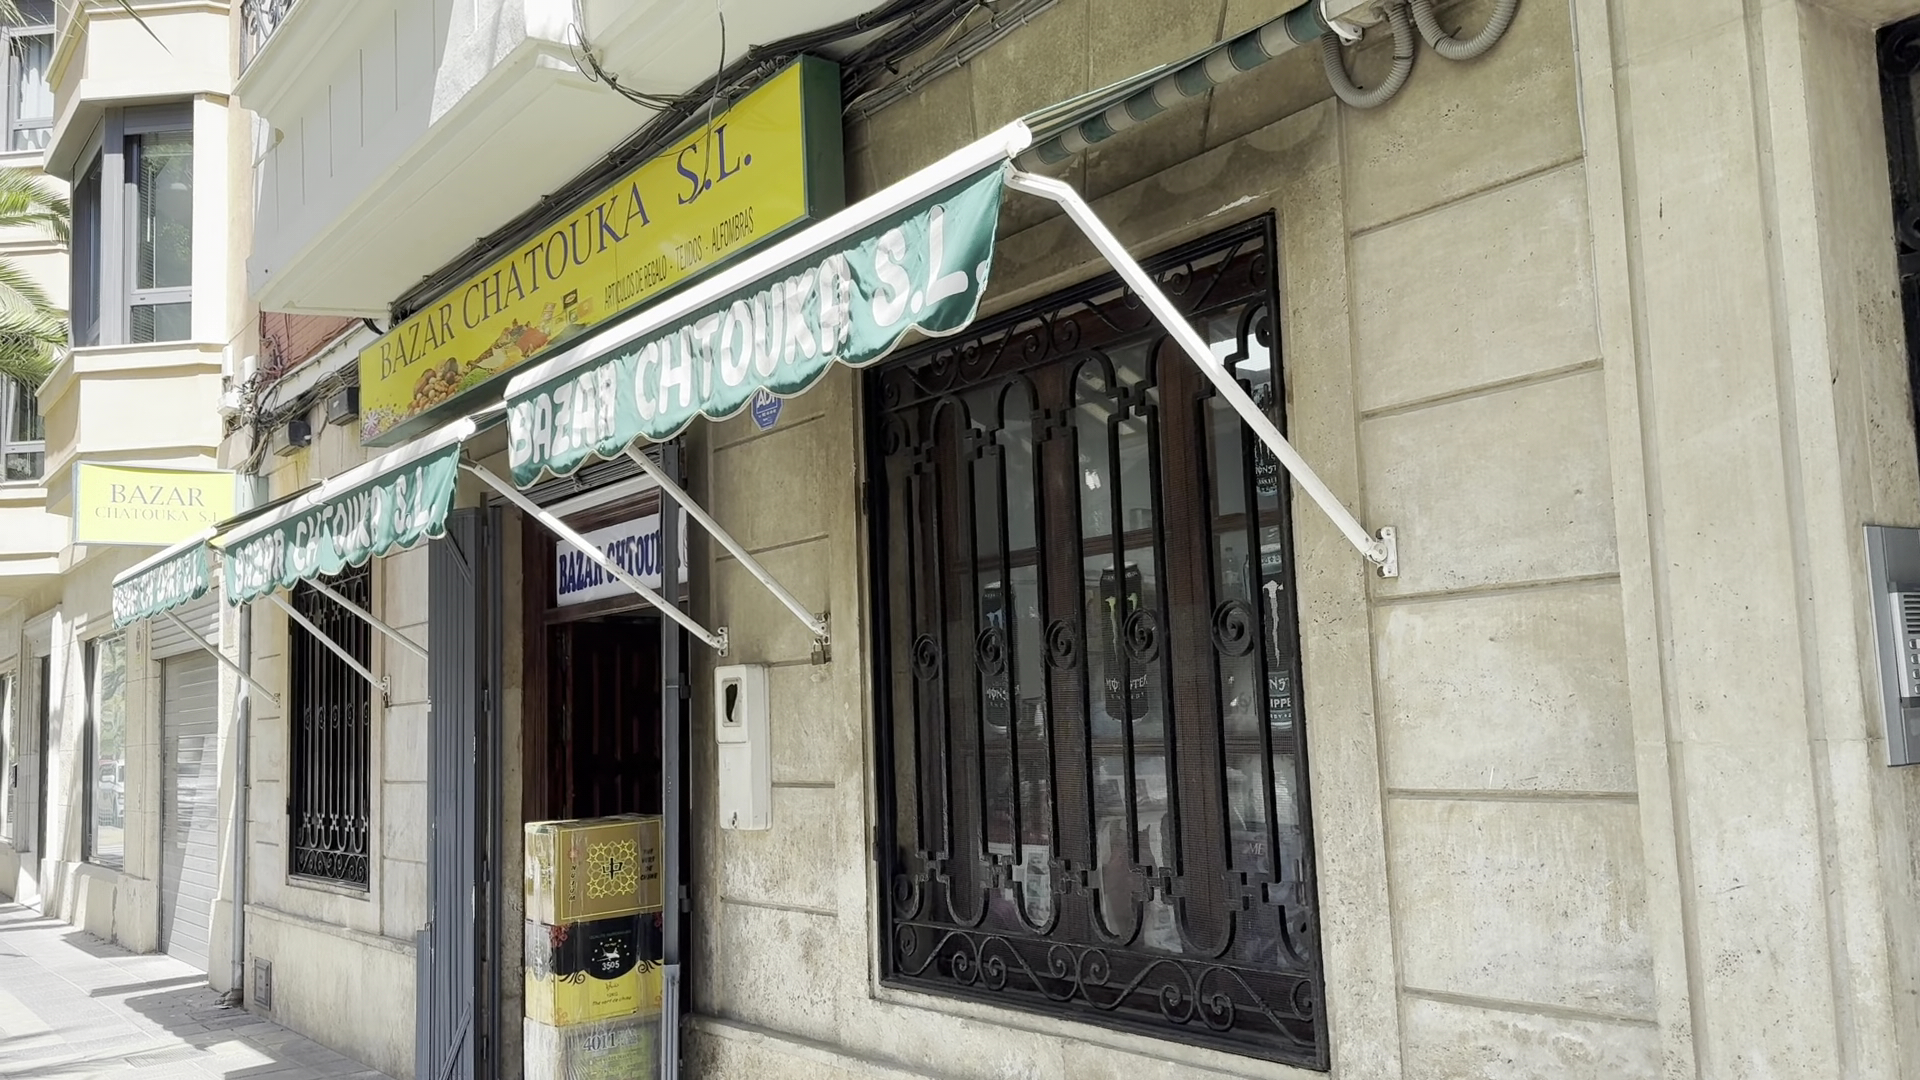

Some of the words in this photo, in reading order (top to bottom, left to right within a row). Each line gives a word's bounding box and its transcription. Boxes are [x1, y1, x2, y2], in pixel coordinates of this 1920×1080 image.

[379, 303, 455, 381] BAZAR
[463, 181, 650, 330] CHATOUKA
[677, 123, 752, 206] S.L.
[643, 255, 667, 289] REGALO
[675, 235, 703, 272] TEJIDOS
[712, 206, 754, 254] ALFOMBRAS
[635, 253, 851, 420] CHTOUKA
[873, 204, 989, 327] S.L.
[110, 483, 204, 507] BAZAR
[95, 506, 189, 522] CHATOUKA
[559, 546, 603, 595] BAZAR
[606, 530, 661, 584] CHTOU
[1106, 674, 1149, 692] MOTER
[1270, 697, 1292, 708] IPPE
[602, 960, 620, 971] 3505
[583, 1032, 616, 1052] 4011
